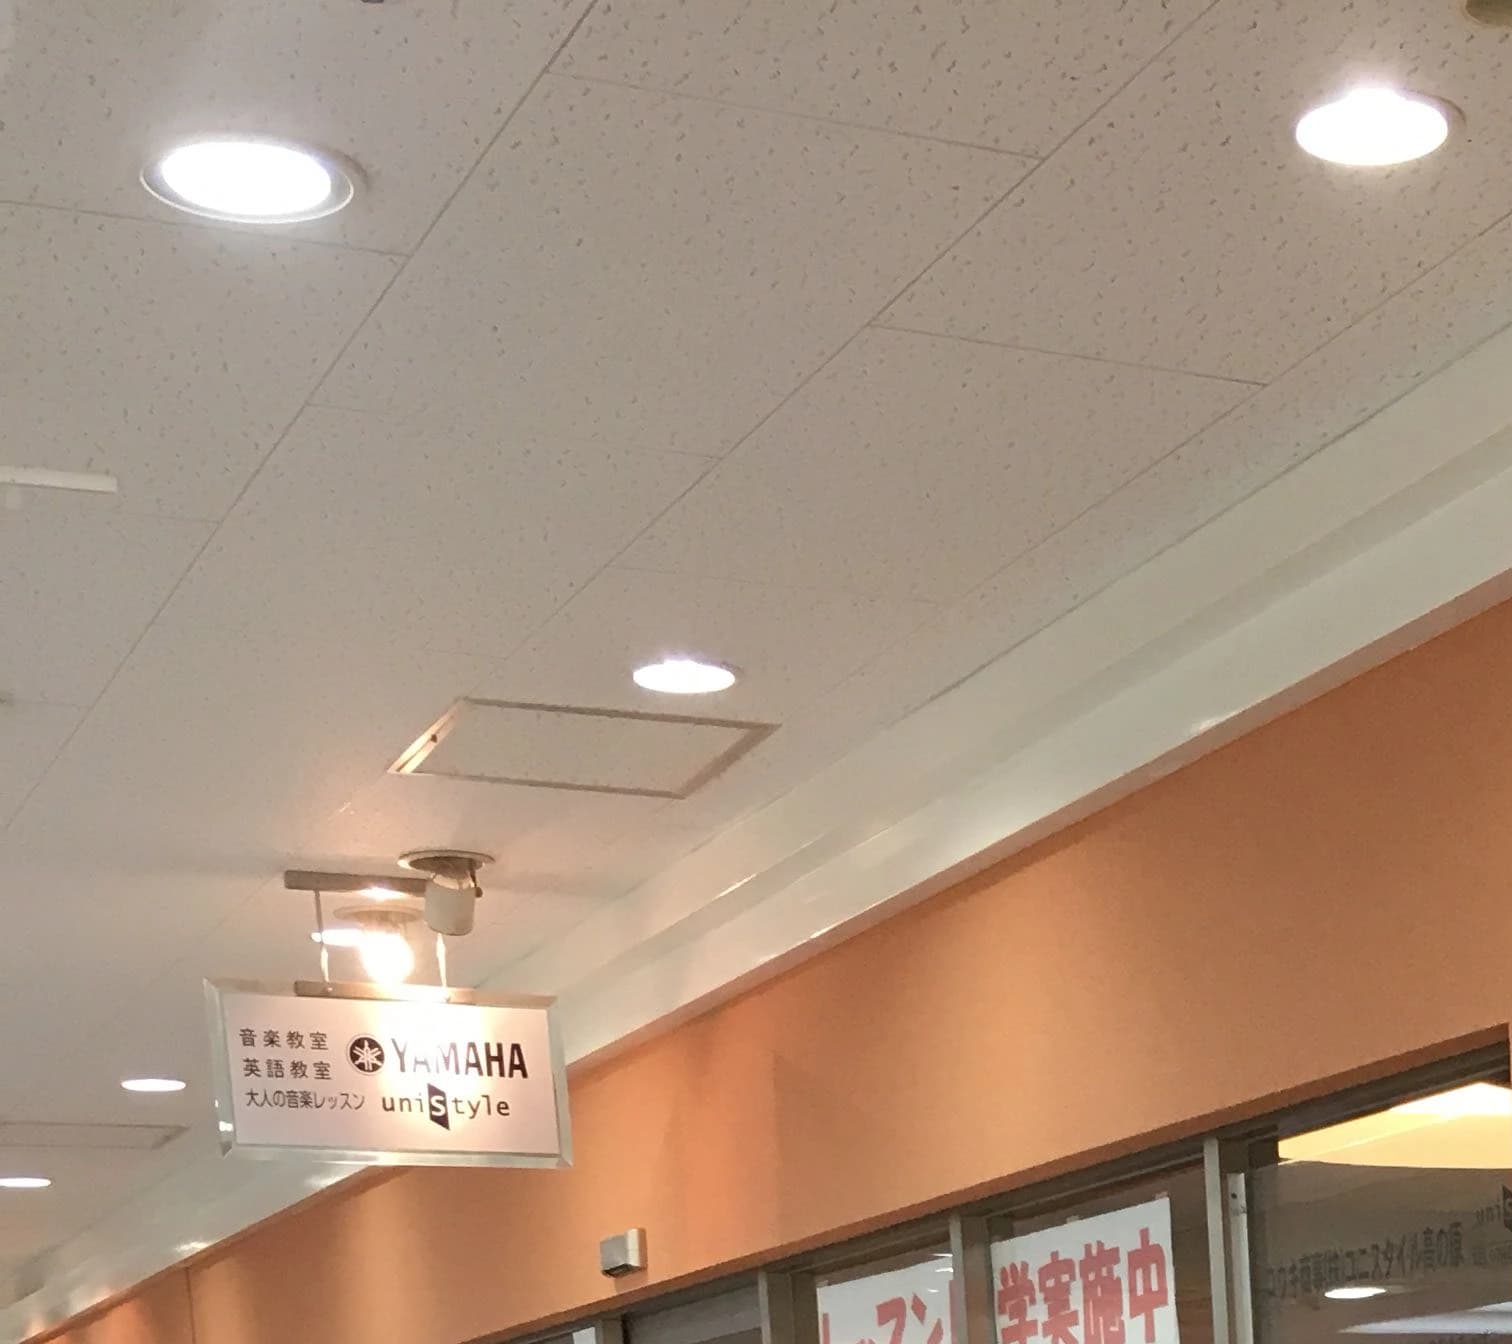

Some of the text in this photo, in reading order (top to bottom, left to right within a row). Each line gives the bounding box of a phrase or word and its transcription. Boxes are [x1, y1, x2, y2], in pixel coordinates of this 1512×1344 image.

[240, 1028, 329, 1051] 音楽教室
[243, 1058, 332, 1081] 英語教室
[391, 1037, 529, 1080] YAMAHA
[245, 1088, 365, 1111] 大人の音楽レッスン
